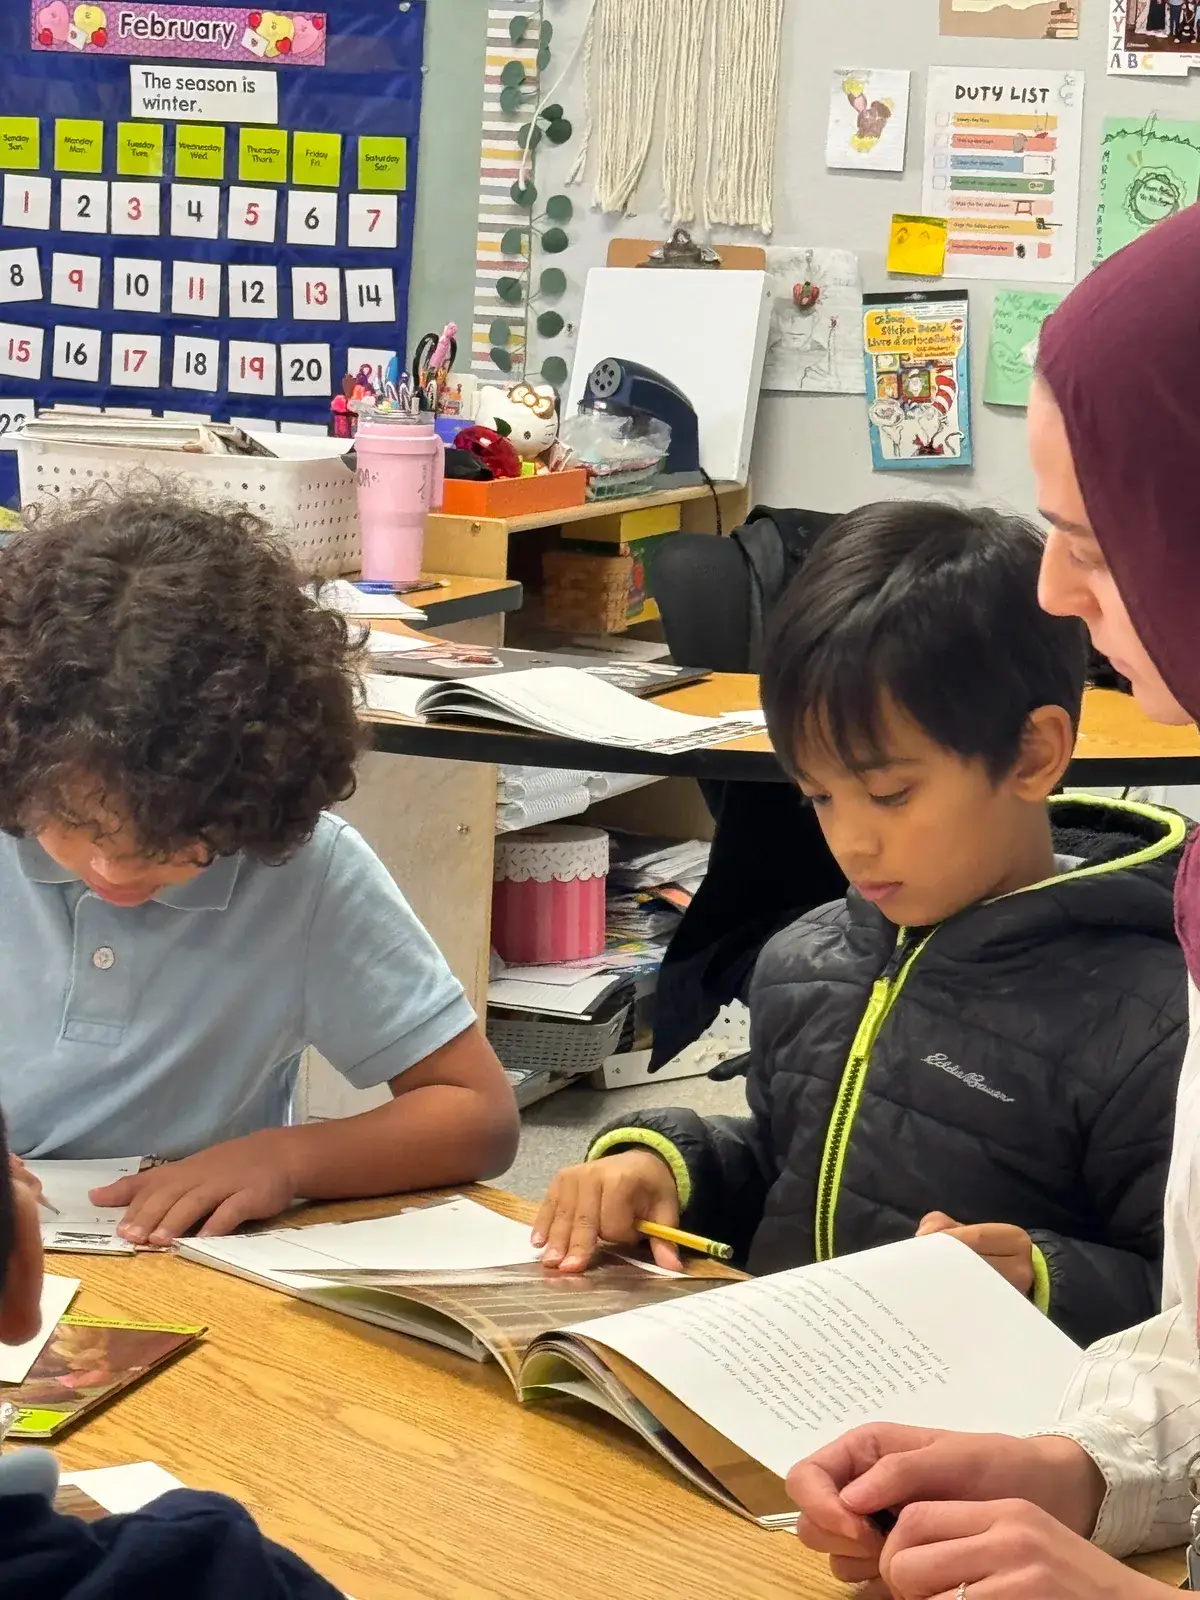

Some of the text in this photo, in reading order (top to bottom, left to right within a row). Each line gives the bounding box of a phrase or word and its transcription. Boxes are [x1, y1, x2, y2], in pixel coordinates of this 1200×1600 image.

[120, 11, 236, 48] February
[142, 71, 256, 94] The season is
[142, 94, 202, 114] winter.
[955, 84, 1050, 104] DUTY LIST
[3, 133, 30, 147] Sunday
[63, 136, 94, 147] Monday
[126, 139, 155, 151] Tuesday
[305, 149, 328, 160] Friday
[365, 153, 399, 164] Saturday
[23, 190, 381, 233] 1 2 3 4 5 6 7
[9, 263, 382, 308] 8 9 10 11 12 13 14
[8, 338, 31, 363] 15
[65, 341, 88, 366] 16
[123, 349, 148, 373] 17
[185, 351, 207, 376] 18
[240, 355, 265, 381] 19
[290, 358, 322, 382] 20
